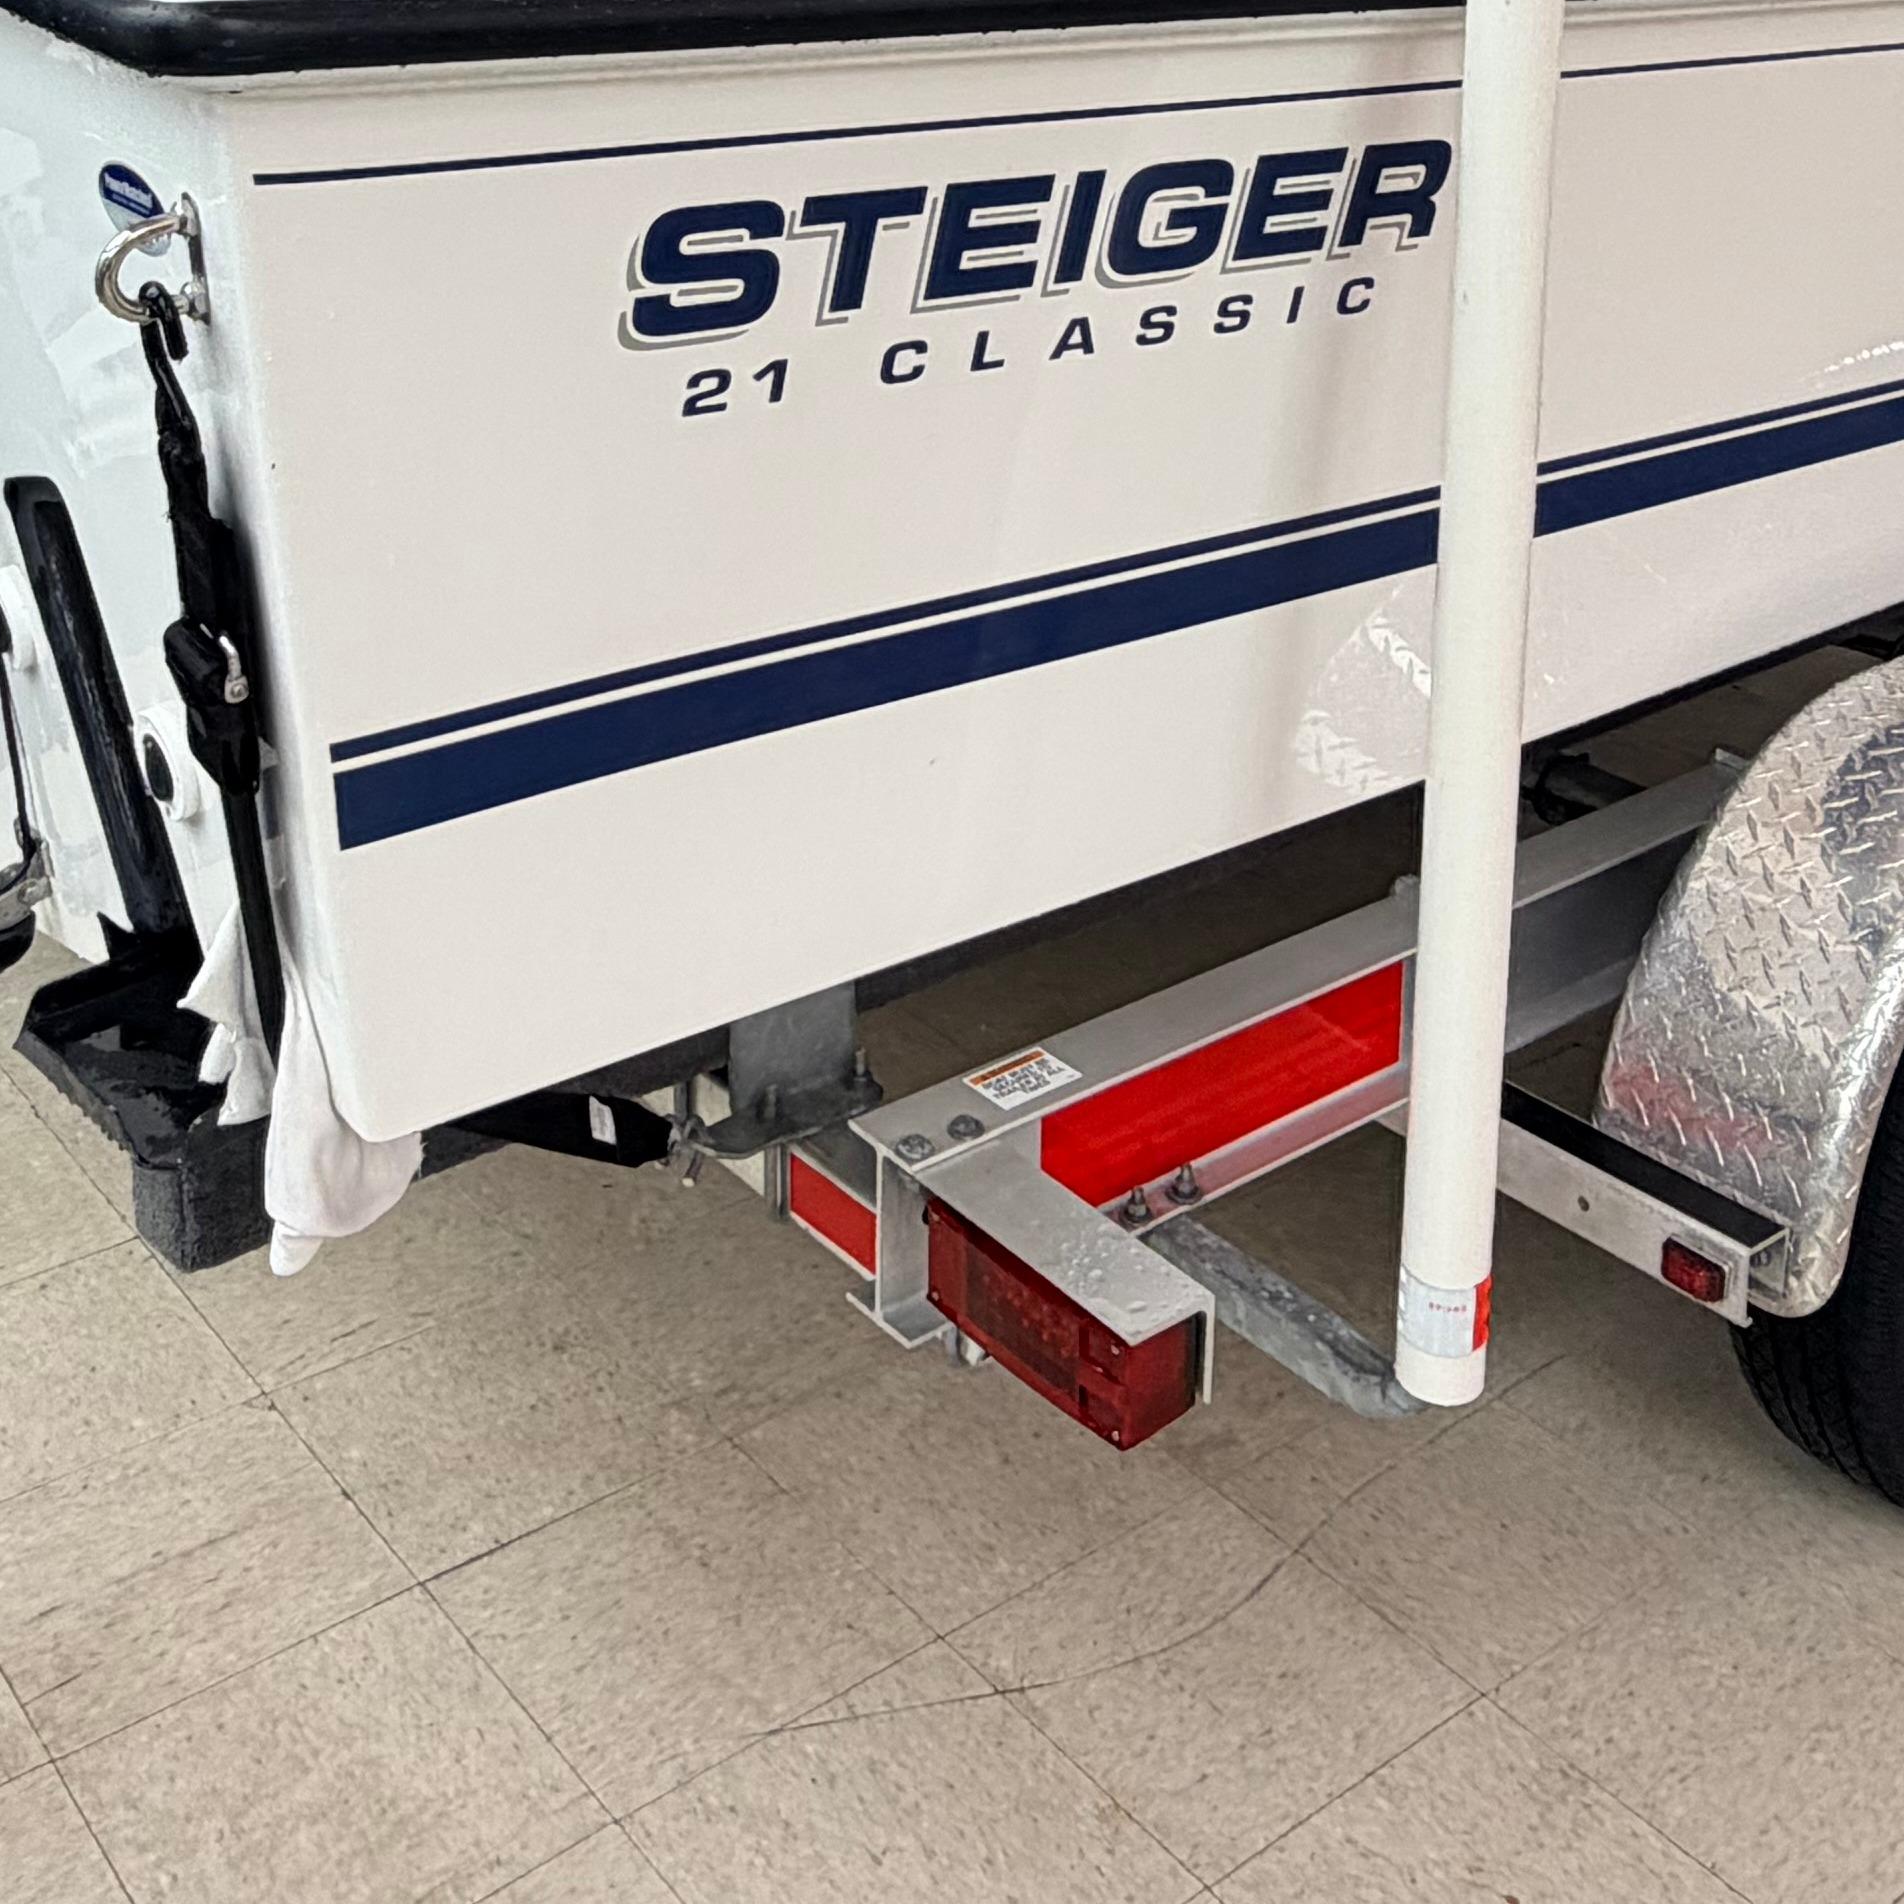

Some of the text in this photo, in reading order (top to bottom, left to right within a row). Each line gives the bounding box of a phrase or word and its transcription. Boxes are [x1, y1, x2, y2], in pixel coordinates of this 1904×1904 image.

[618, 138, 1453, 351] STEIGER
[681, 275, 1377, 417] 21 CLASSIC
